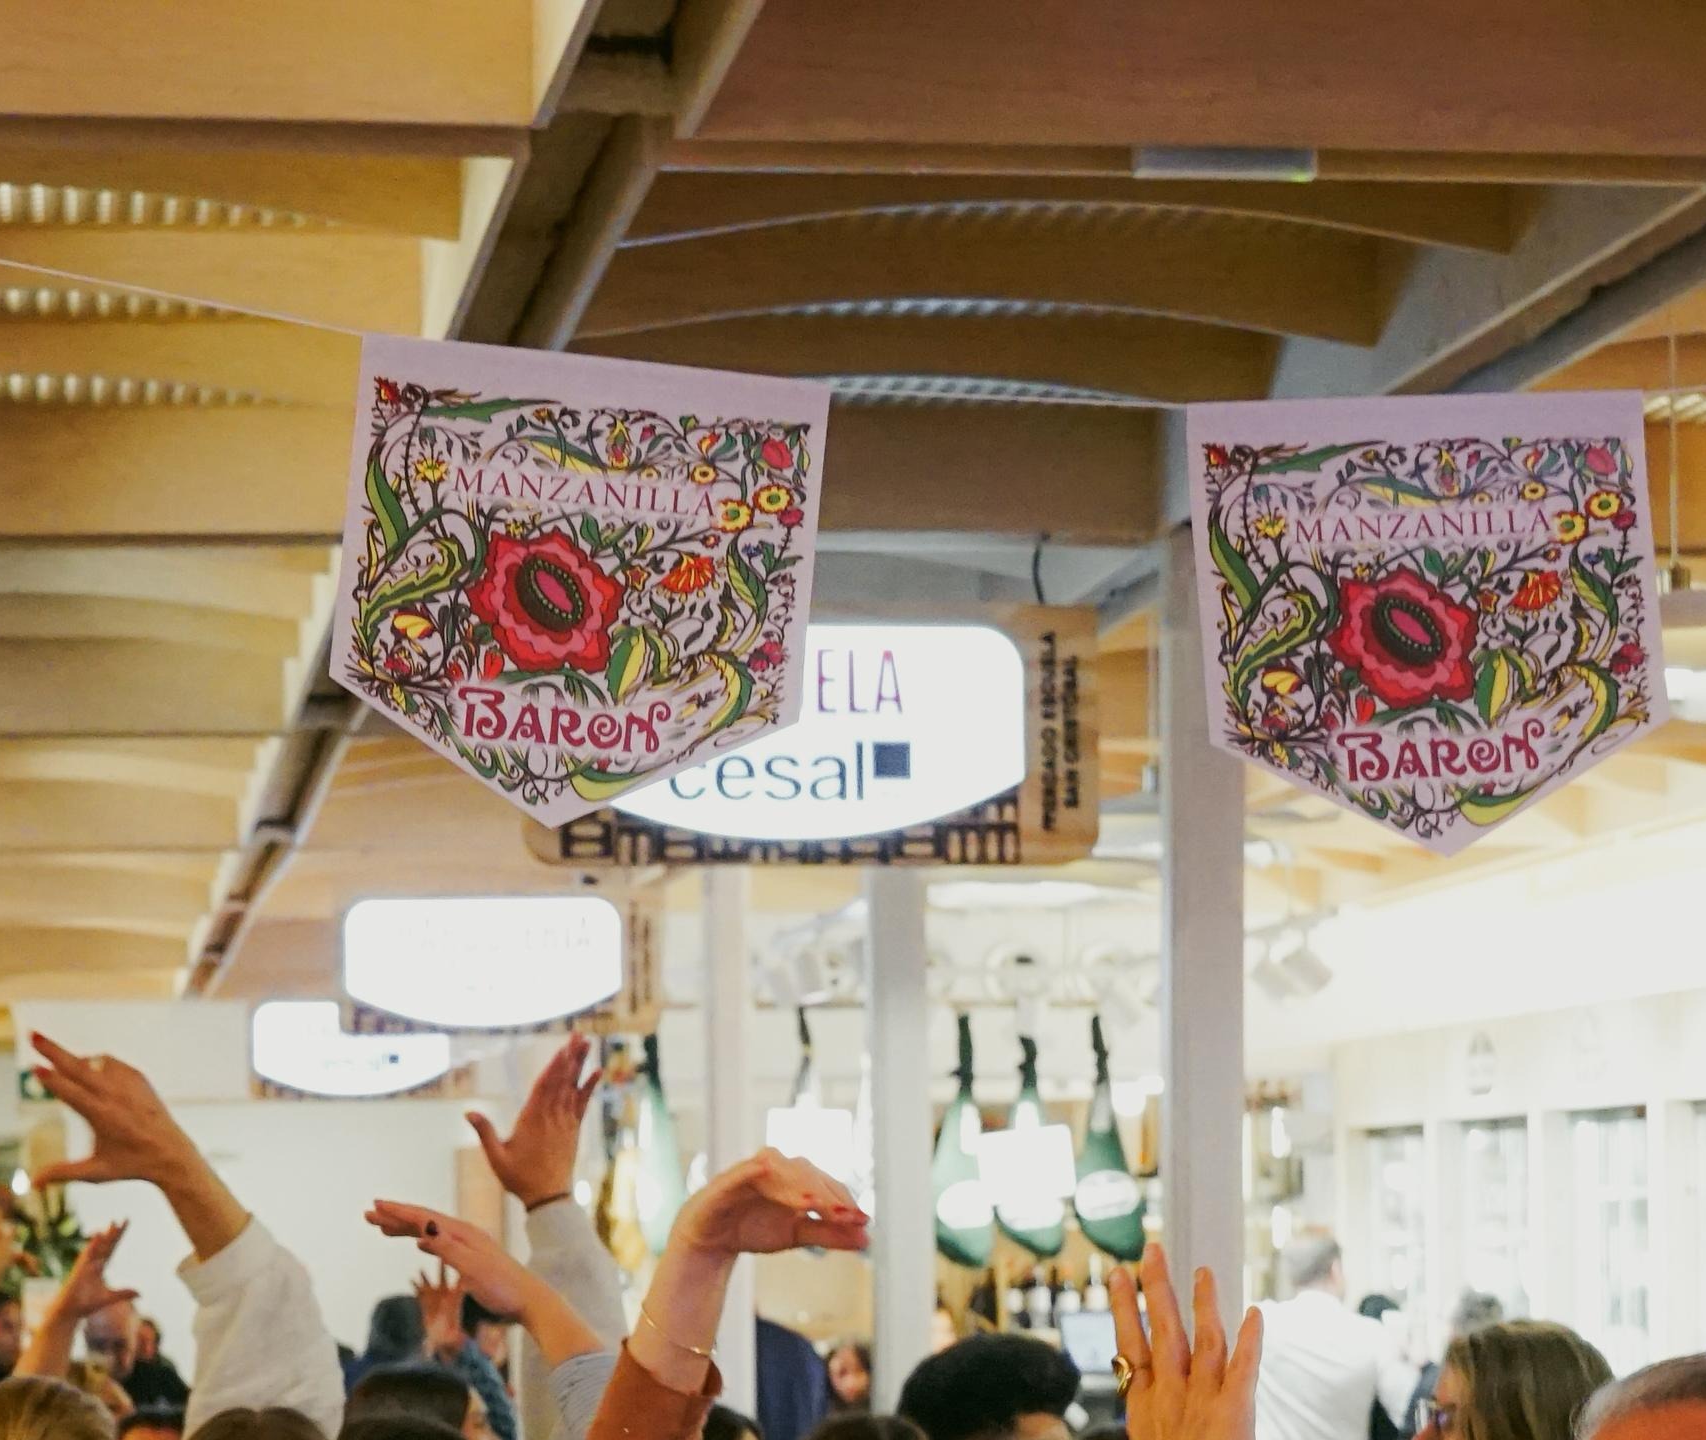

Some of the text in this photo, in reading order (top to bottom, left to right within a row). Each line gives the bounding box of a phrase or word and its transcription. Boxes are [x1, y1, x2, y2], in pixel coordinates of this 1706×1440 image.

[453, 466, 717, 517] MANZANILLA
[1294, 507, 1553, 544] MANZANILLA
[458, 686, 672, 753] BARON
[669, 741, 864, 801] cesal
[1337, 718, 1546, 783] BARON
